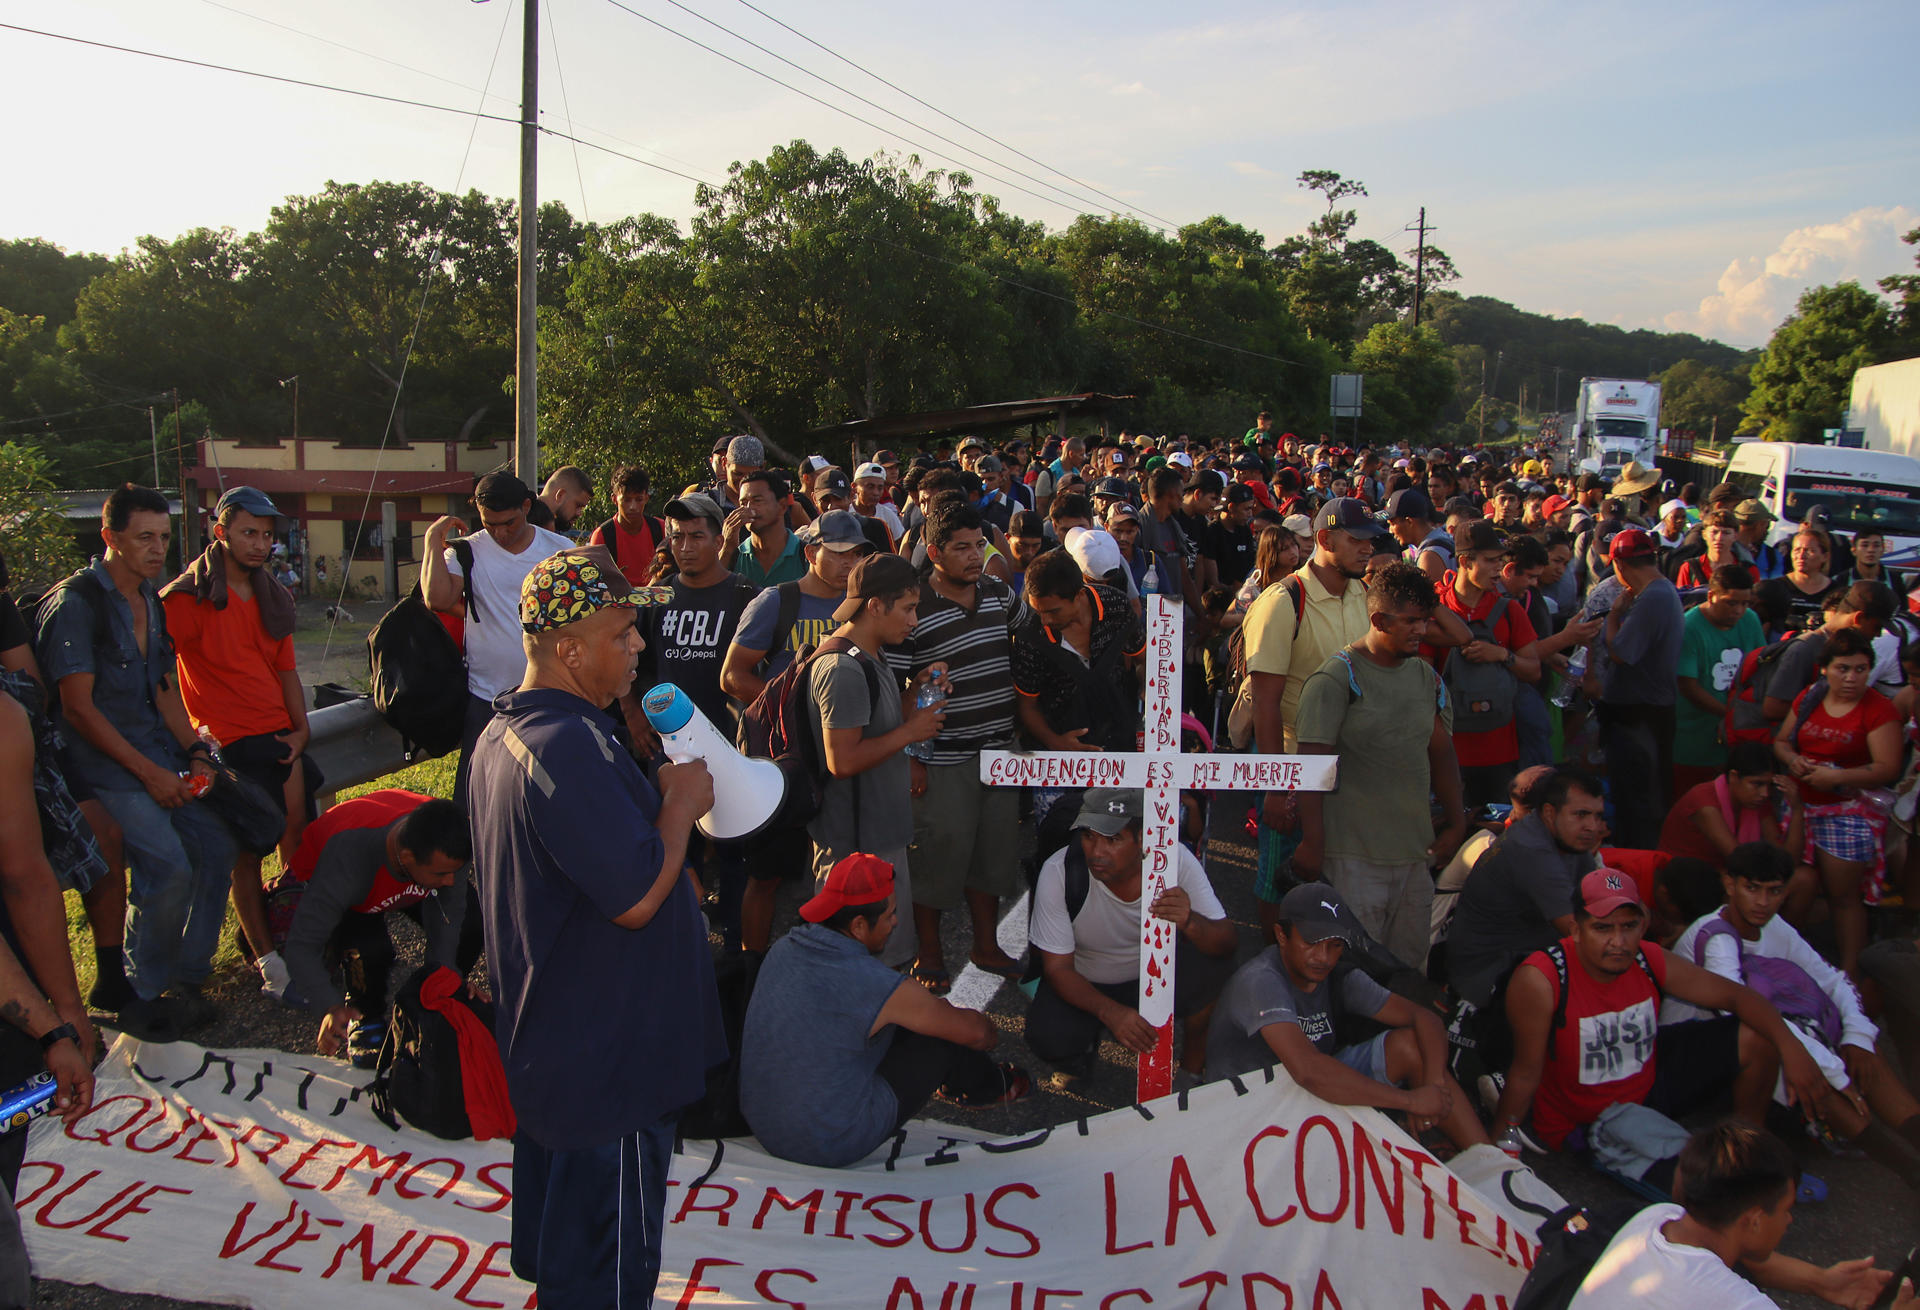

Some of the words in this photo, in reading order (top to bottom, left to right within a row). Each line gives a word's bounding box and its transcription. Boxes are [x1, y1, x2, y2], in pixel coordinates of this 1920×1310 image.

[1327, 514, 1336, 527] 10
[662, 610, 726, 647] #CBJ
[785, 618, 845, 652] NIR
[692, 649, 716, 660] pepsi
[1157, 595, 1172, 746] LIBERTAD
[990, 757, 1126, 780] CONTENCION
[1146, 761, 1174, 780] ES
[1193, 761, 1221, 782] MI
[1232, 761, 1304, 782] MUERTE
[1152, 801, 1170, 900] VIDA
[1585, 1012, 1654, 1052] JUST
[1585, 1046, 1622, 1074] DO
[1634, 1034, 1656, 1064] IT
[64, 1094, 513, 1213] QUEREMOS
[667, 1180, 1041, 1258] RMISUS
[1104, 1155, 1217, 1256] LA
[218, 1199, 538, 1310] VENDE
